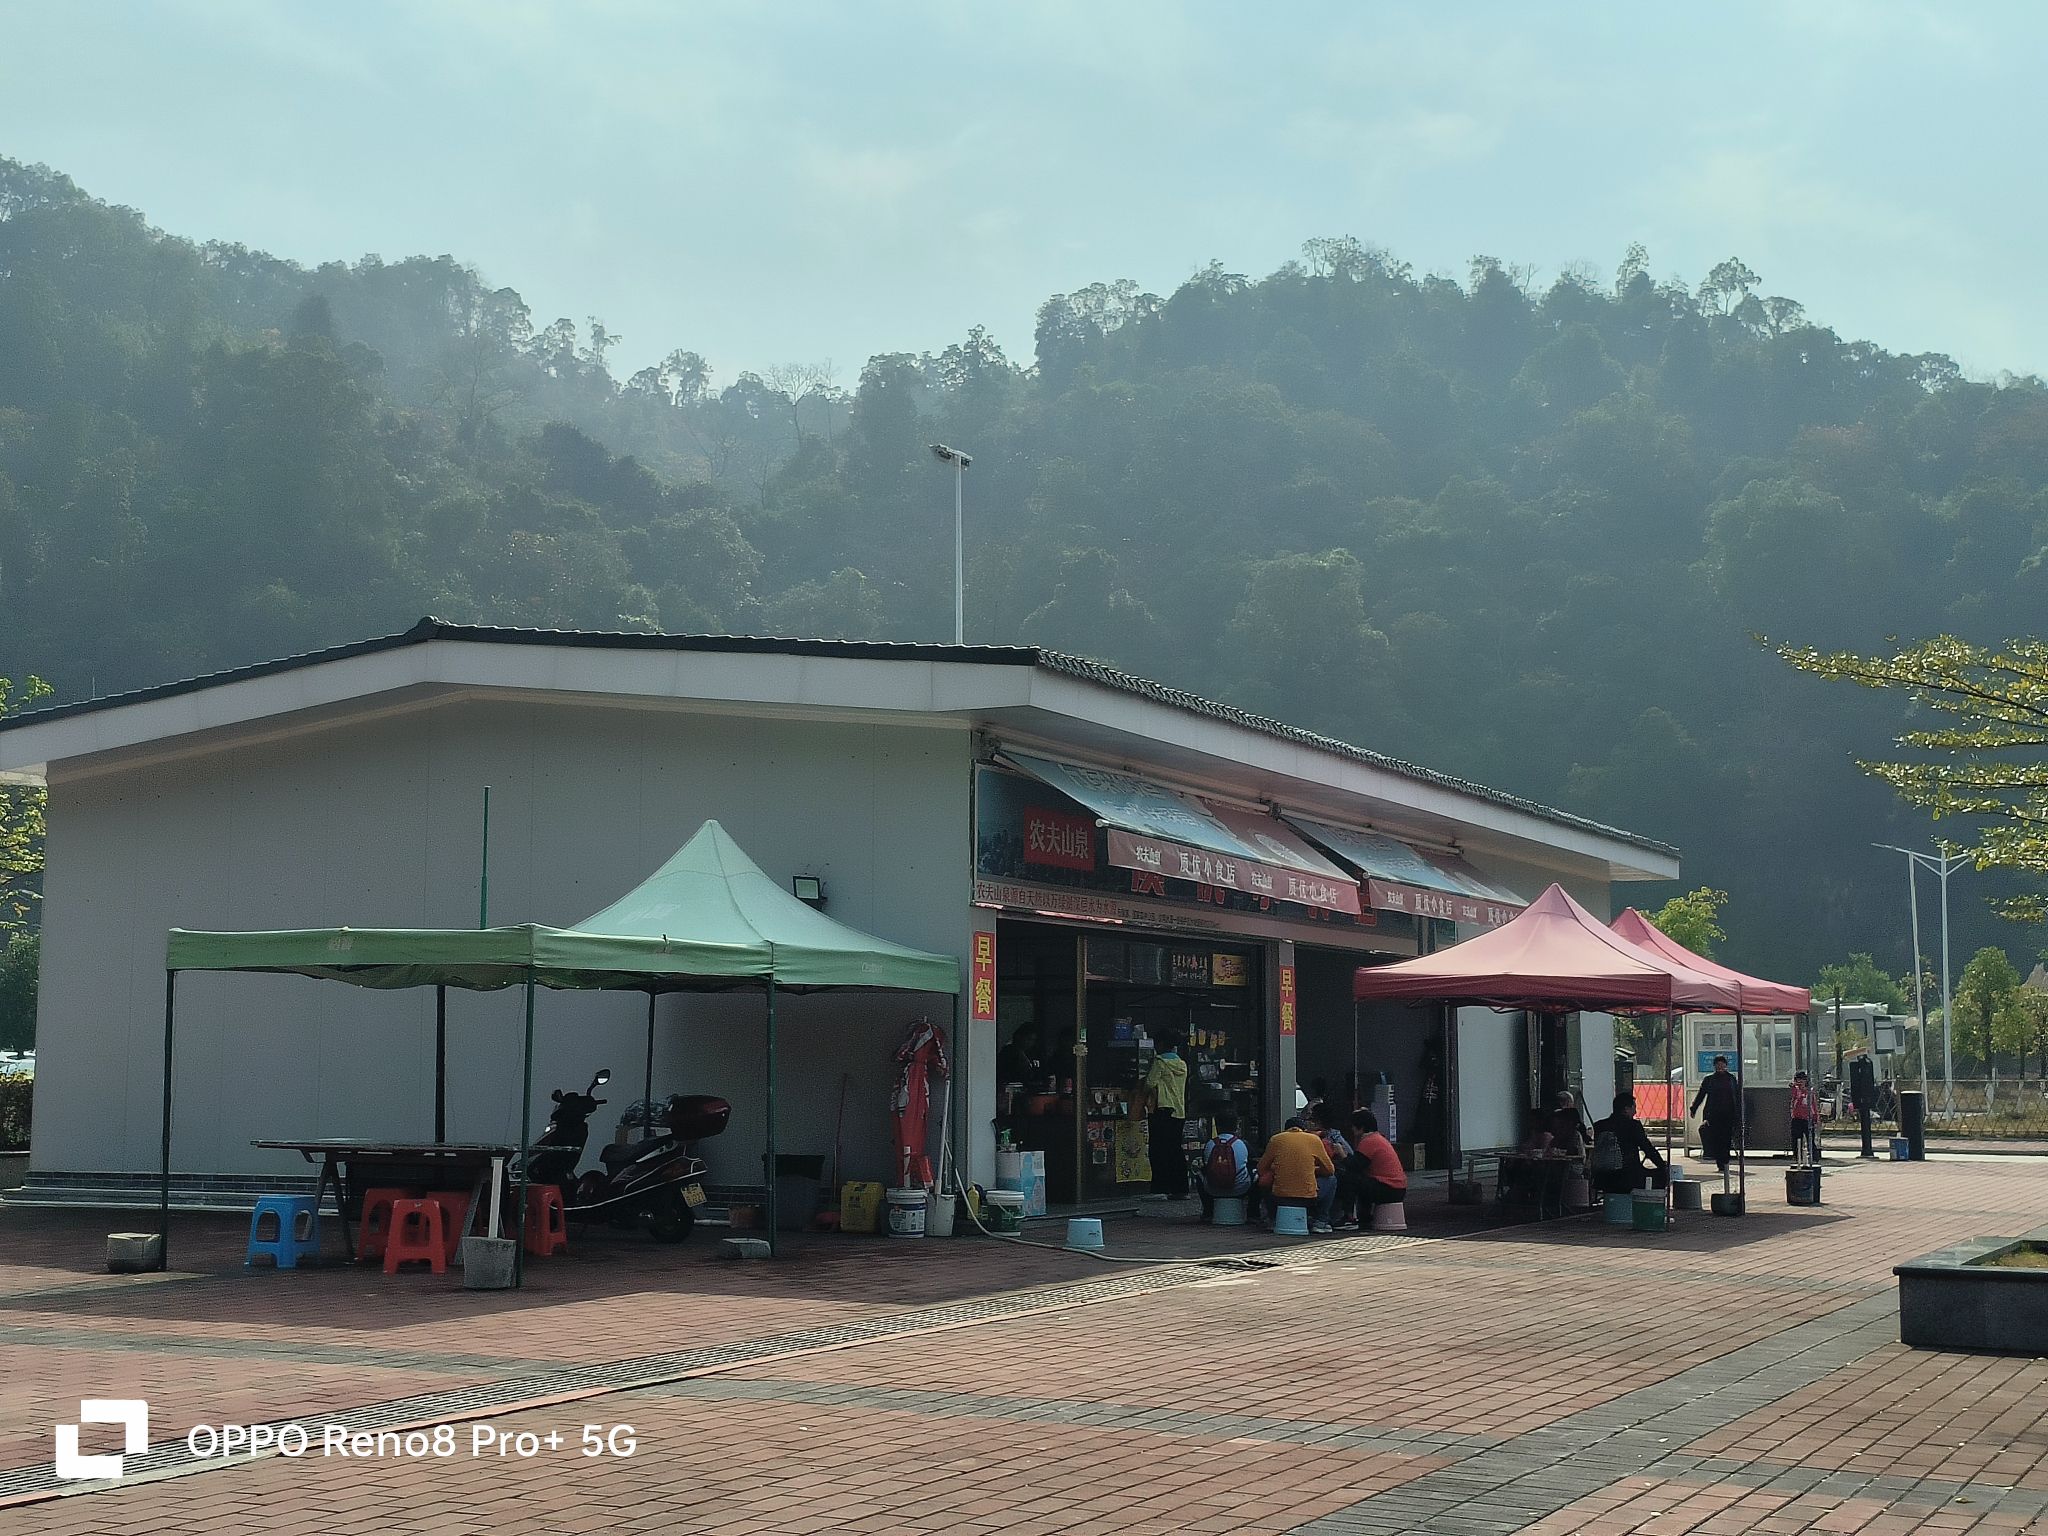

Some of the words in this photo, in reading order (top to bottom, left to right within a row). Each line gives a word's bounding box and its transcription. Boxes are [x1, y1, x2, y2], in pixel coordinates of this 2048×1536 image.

[1029, 819, 1089, 859] 农夫山泉
[1179, 852, 1236, 884] 质优小食店
[976, 936, 993, 1015] 早餐
[1281, 969, 1293, 1031] 早餐
